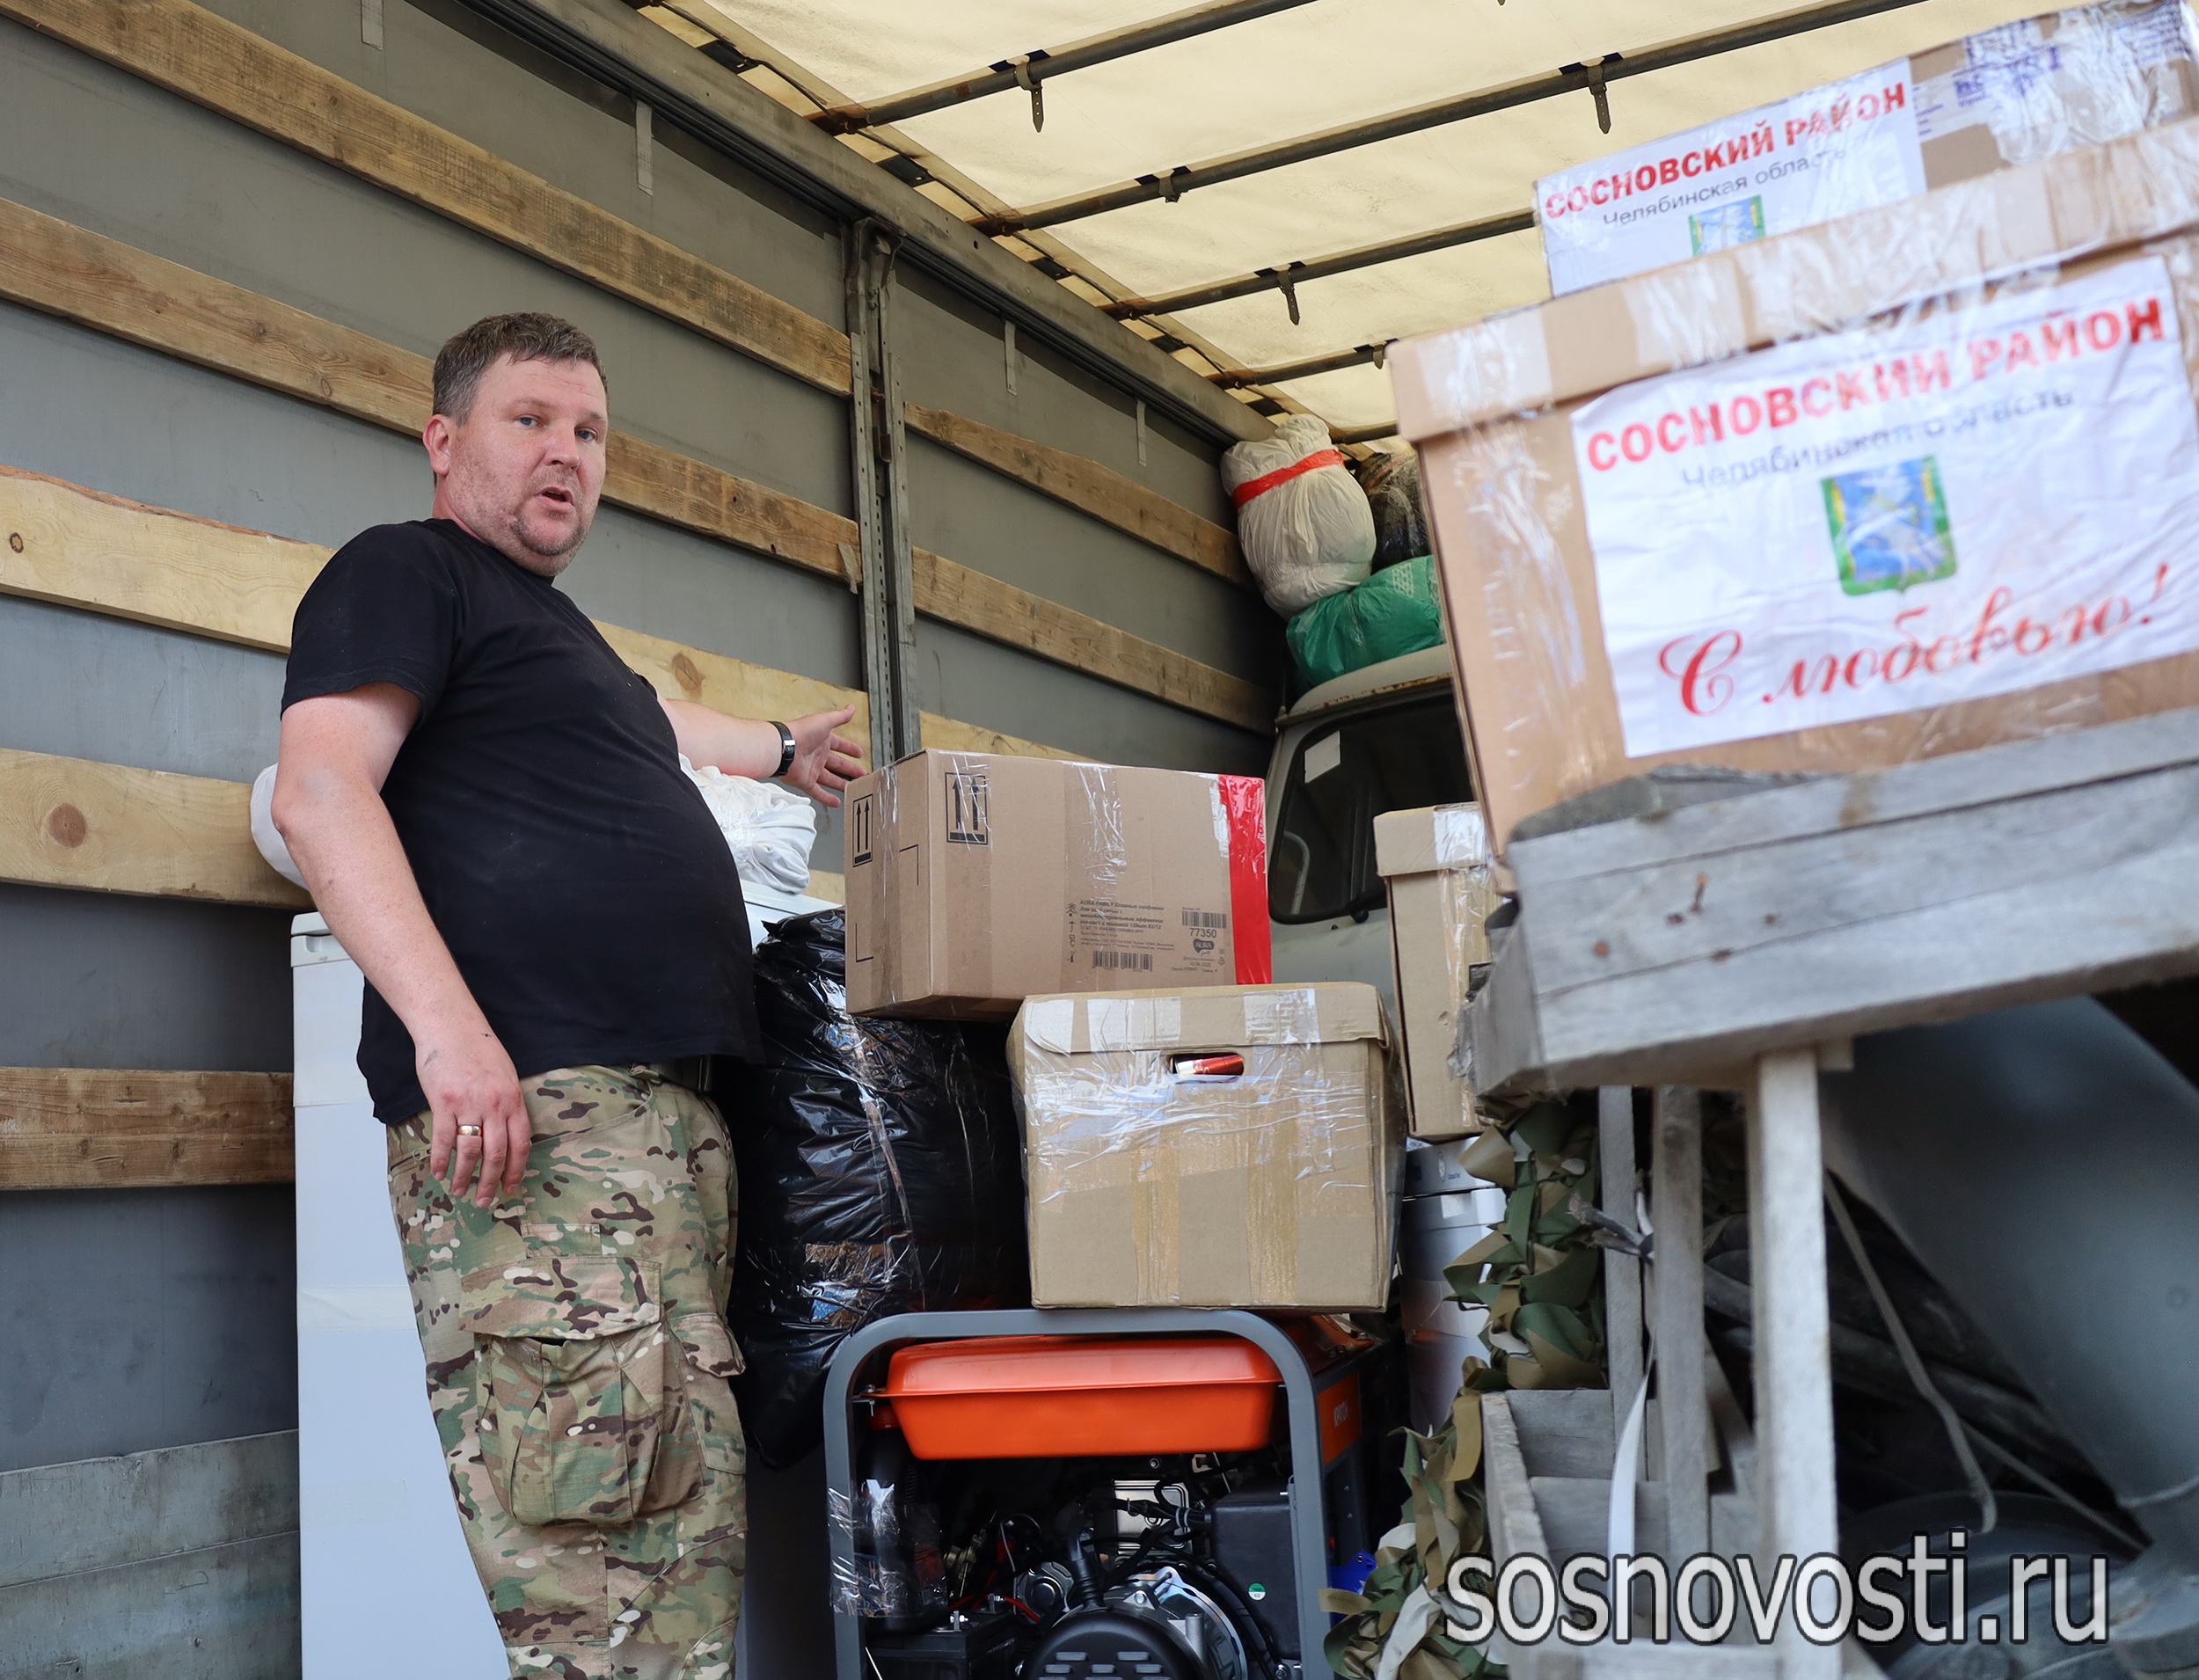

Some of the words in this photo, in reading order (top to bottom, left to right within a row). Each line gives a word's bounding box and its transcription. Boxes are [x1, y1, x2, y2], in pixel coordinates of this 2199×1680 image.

[1545, 120, 1774, 219] СОСНОВСКИЙ
[1785, 82, 1907, 147] РАЙОН
[1603, 177, 1749, 226] Челябинская
[1968, 296, 2165, 381] РАЙОН
[1658, 629, 1744, 719] С
[1762, 561, 2170, 705] любовью!
[1189, 927, 1217, 939] 77350
